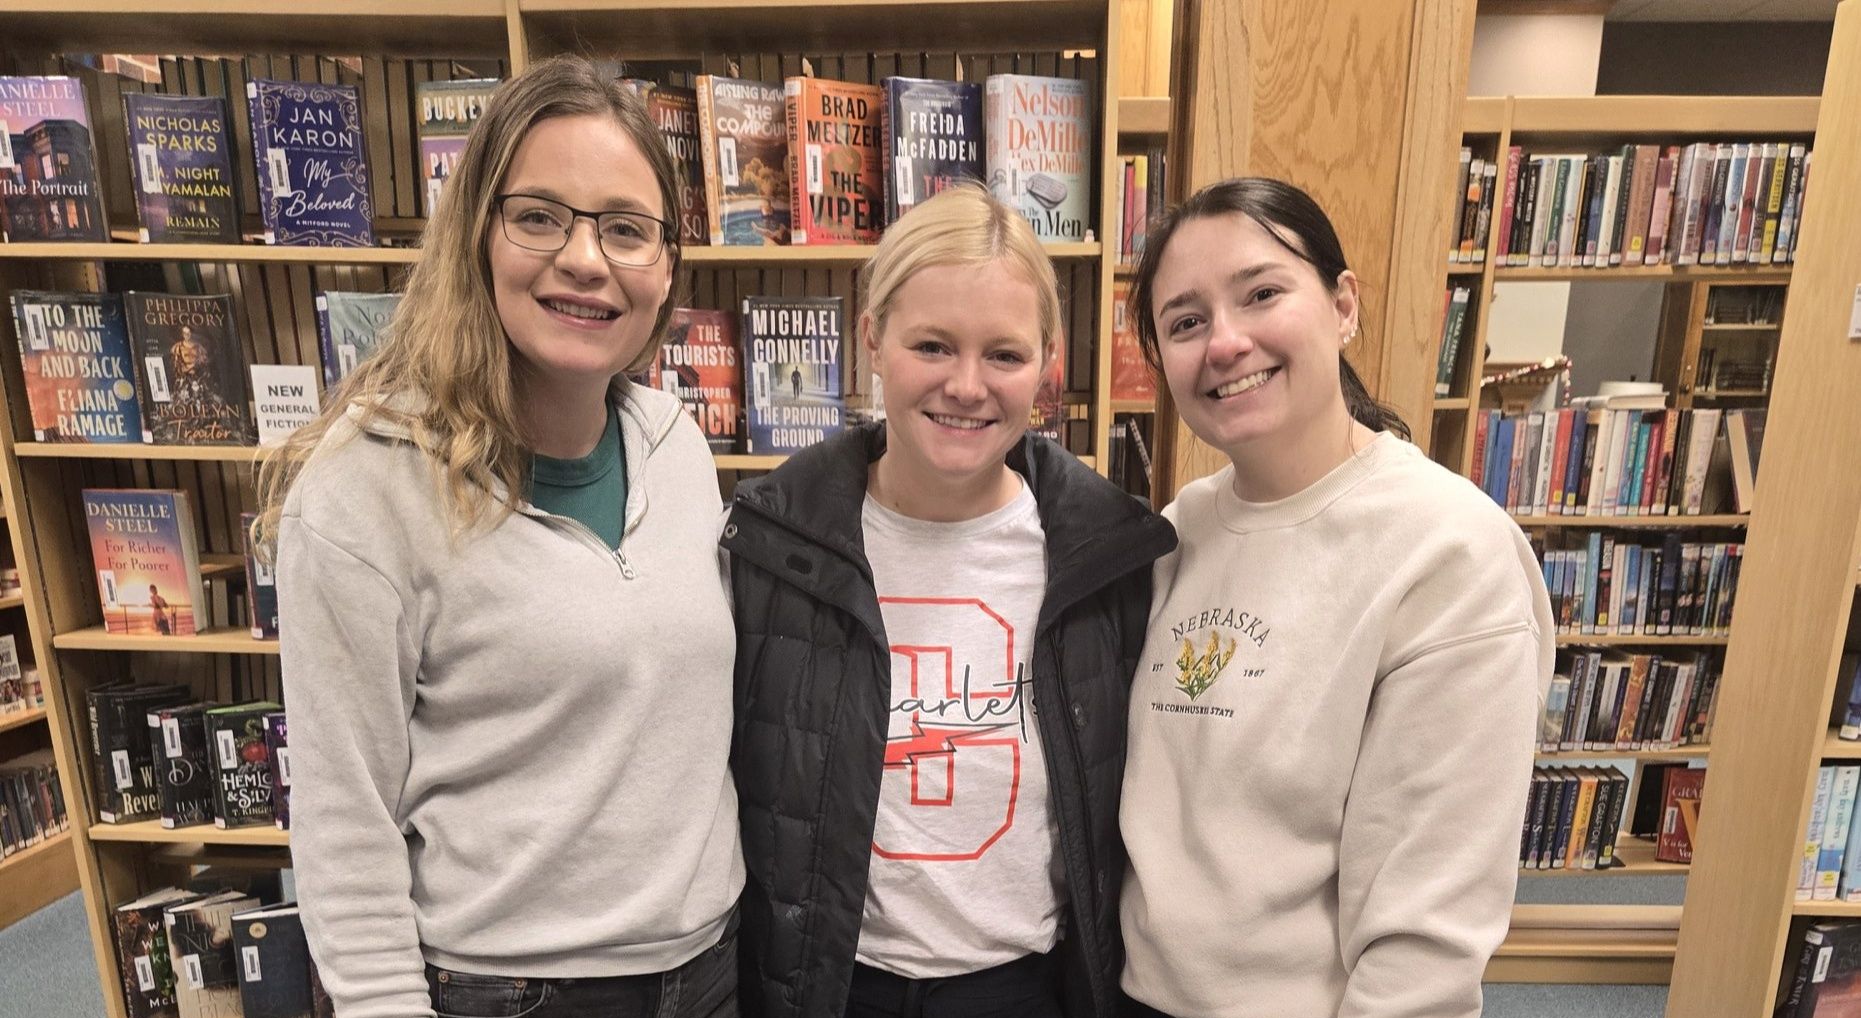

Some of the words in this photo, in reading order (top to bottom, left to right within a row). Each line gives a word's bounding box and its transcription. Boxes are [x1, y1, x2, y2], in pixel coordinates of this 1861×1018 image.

[761, 87, 786, 102] RAW
[1012, 82, 1085, 117] Nelson
[3, 102, 61, 117] STEEL
[289, 107, 333, 126] JAN
[422, 95, 495, 122] BUCKEY
[822, 94, 867, 120] BRAD
[137, 116, 221, 134] NICHOLAS
[658, 107, 698, 136] JANET
[787, 102, 797, 142] VIPER
[910, 111, 965, 136] FREIDA
[146, 132, 217, 153] SPARKS
[273, 127, 353, 148] KARON
[807, 119, 882, 149] MELTZER
[666, 135, 700, 161] NOVI
[897, 137, 976, 162] McFADDEN
[175, 167, 220, 181] NIGHT
[303, 157, 347, 188] My
[831, 171, 863, 195] THE
[0, 179, 27, 196] The
[32, 179, 89, 196] Portrait
[162, 182, 231, 197] YAMALAN
[285, 190, 355, 217] Beloved
[166, 216, 220, 229] REMAIN
[1045, 210, 1081, 238] Men
[42, 304, 65, 328] TO
[71, 304, 105, 328] THE
[145, 298, 222, 312] PHILIPPA
[145, 312, 225, 326] GREGORY
[752, 309, 839, 336] MICHAEL
[52, 329, 104, 353] MOON
[696, 325, 721, 342] THE
[663, 344, 735, 367] TOURISTS
[753, 339, 839, 364] CONNELLY
[41, 355, 75, 378] AND
[78, 355, 125, 379] BACK
[57, 388, 119, 412] ELIANA
[267, 385, 304, 397] NEW
[678, 387, 731, 399] HRISTOPHER
[159, 403, 240, 418] BOLEYN
[260, 404, 314, 414] GENERAL
[757, 406, 779, 426] THE
[783, 407, 839, 427] PROVING
[57, 414, 127, 437] RAMAGE
[167, 419, 231, 440] Traitor
[86, 502, 170, 519] DANIELLE
[105, 519, 158, 533] STEEL
[105, 540, 124, 554] For
[128, 540, 167, 554] Richer
[108, 557, 127, 570] For
[131, 558, 169, 571] Poorer
[1171, 608, 1270, 648] NEBRASKA
[889, 662, 1039, 744] arlet
[1151, 702, 1163, 712] THE
[1165, 704, 1208, 715] CORNHUSKER
[1210, 707, 1234, 718] STATE
[1591, 801, 1606, 844] GRAFTON
